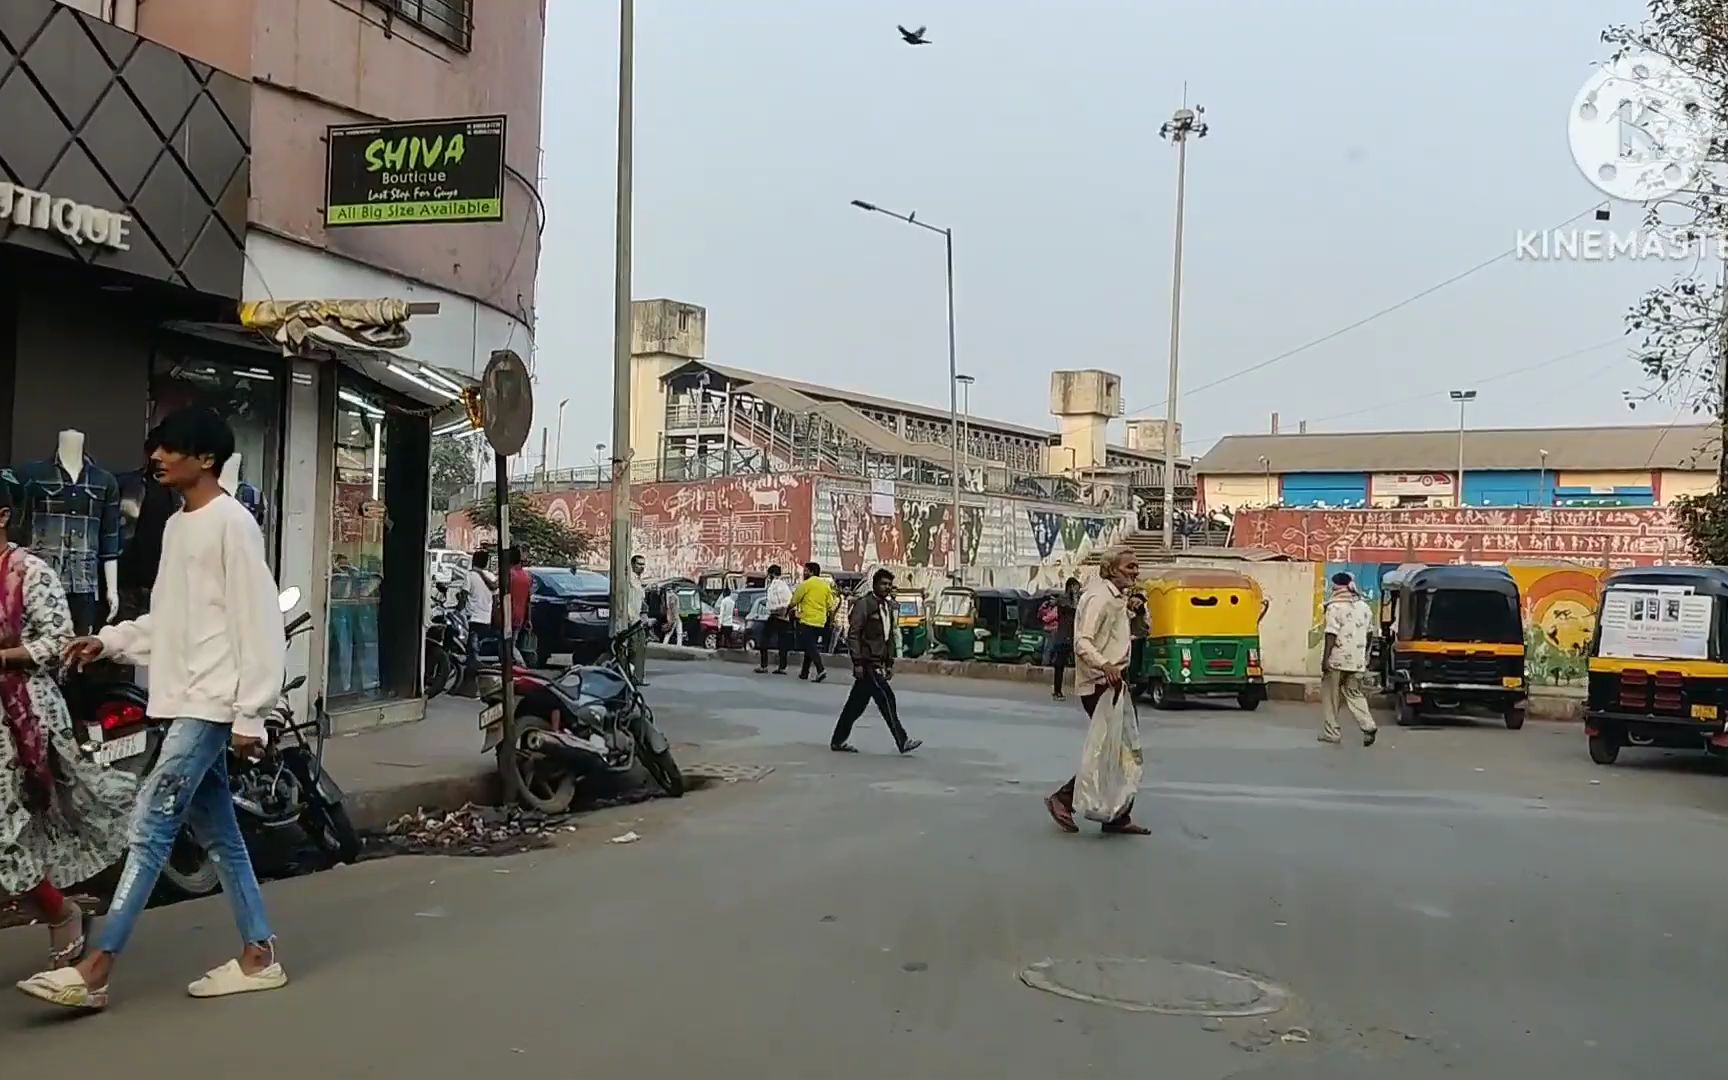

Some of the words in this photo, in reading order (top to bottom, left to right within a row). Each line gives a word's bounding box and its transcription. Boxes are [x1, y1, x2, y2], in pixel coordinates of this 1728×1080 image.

[365, 134, 465, 173] SHIVA
[382, 172, 447, 186] Boutique
[368, 188, 388, 201] Last
[391, 187, 410, 200] Stop
[414, 186, 431, 198] For
[434, 186, 459, 199] Guys
[337, 206, 356, 220] All
[361, 206, 382, 220] Big
[387, 204, 414, 217] Size
[419, 201, 490, 216] Available
